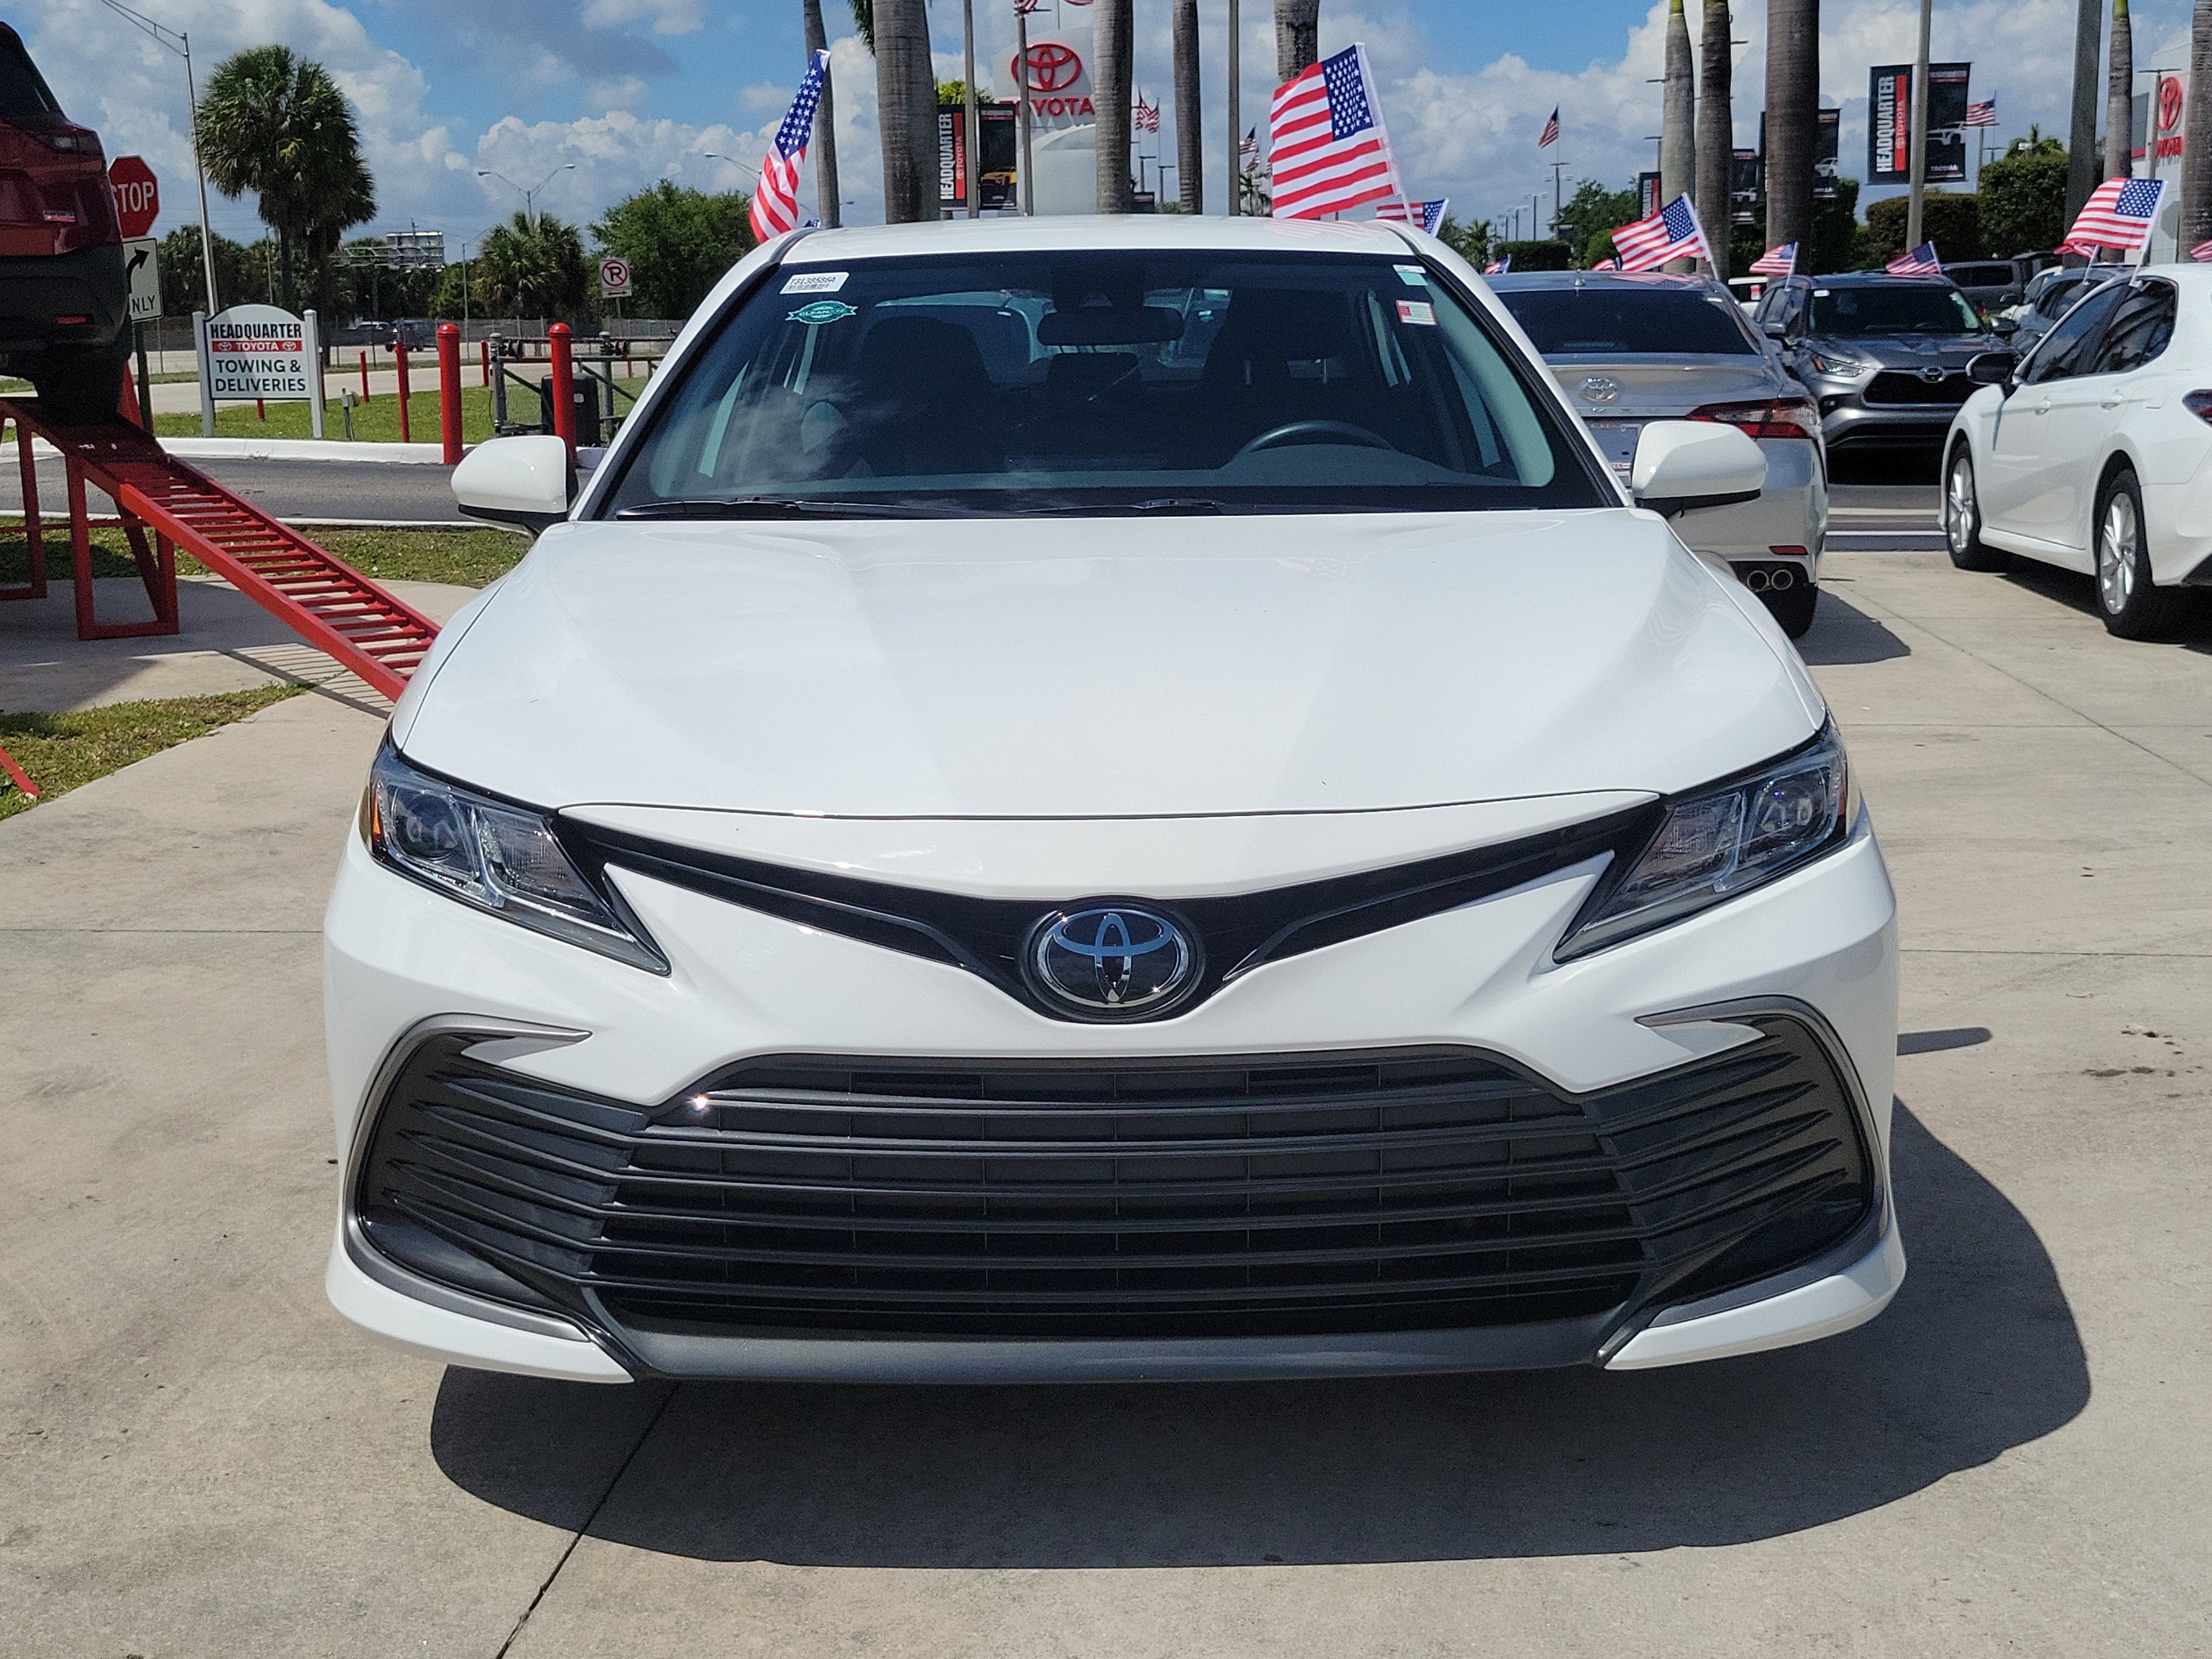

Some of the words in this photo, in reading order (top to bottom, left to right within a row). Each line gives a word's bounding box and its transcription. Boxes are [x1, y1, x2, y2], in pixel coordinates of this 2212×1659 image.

[999, 97, 1095, 117] YOTA
[1876, 76, 1895, 172] HEADQUARTER
[938, 113, 955, 200] HEADQUARTER
[132, 295, 155, 314] NLY
[210, 324, 302, 340] HEADQUARTER
[236, 342, 279, 351] TOYOTA
[216, 359, 286, 373] TOWING
[290, 359, 302, 373] &
[216, 378, 306, 392] DELIVERIES
